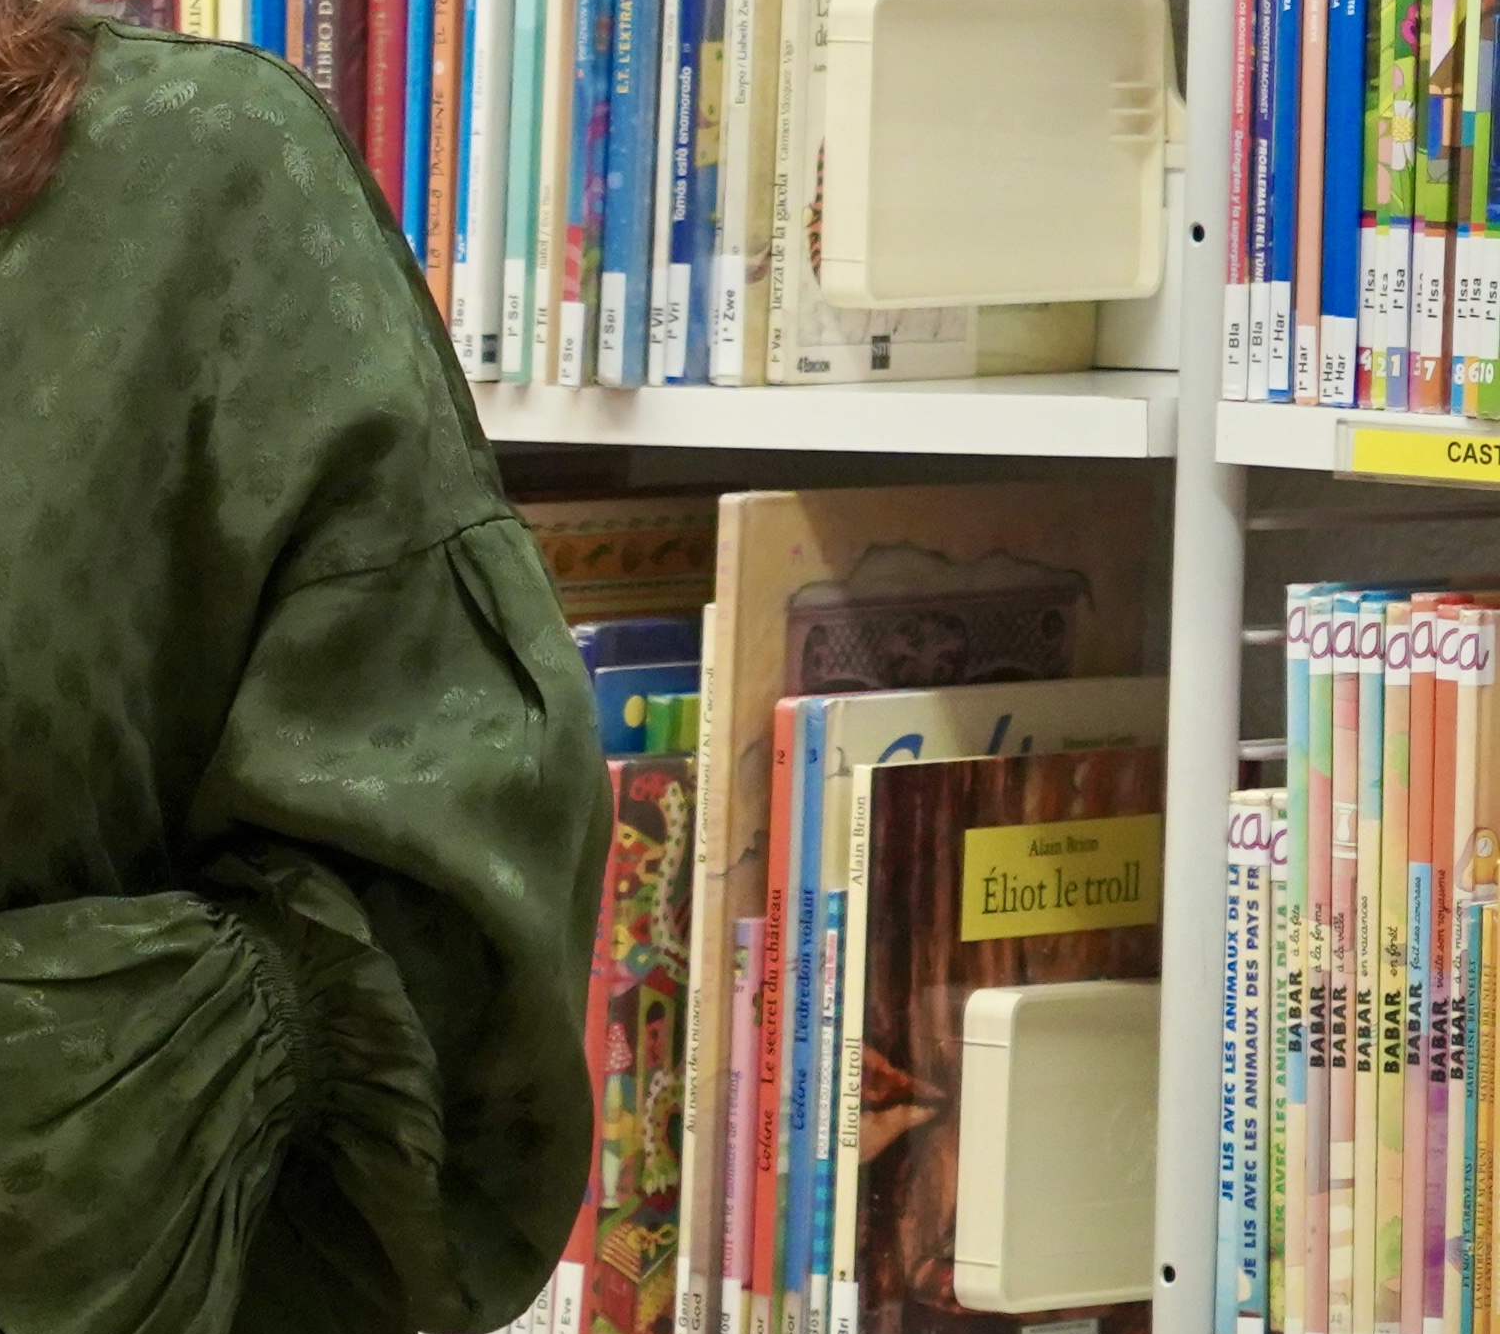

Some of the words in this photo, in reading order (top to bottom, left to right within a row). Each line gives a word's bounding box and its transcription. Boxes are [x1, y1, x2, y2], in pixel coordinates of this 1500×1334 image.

[1261, 15, 1271, 62] MONSTER
[677, 66, 693, 144] enamorado
[1257, 138, 1268, 215] PROBLEMAS
[673, 179, 688, 221] Tomás
[851, 796, 867, 838] Brion
[850, 843, 866, 886] Alain
[1028, 836, 1060, 858] Alain
[1063, 835, 1100, 857] Brion
[981, 870, 1036, 917] Éliot
[1053, 876, 1080, 910] le
[1085, 861, 1141, 906] troll
[764, 888, 782, 963] château
[1246, 900, 1260, 950] PAYS
[1224, 931, 1239, 1032] ANIMAUX
[1245, 959, 1259, 998] DES
[1288, 969, 1302, 1052] BABAR
[1309, 983, 1326, 1068] BABAR
[1331, 984, 1347, 1068] BABAR
[1356, 988, 1372, 1073] BABAR
[1383, 989, 1401, 1074] BABAR
[763, 1012, 778, 1056] secret
[761, 1060, 776, 1086] Le
[843, 1037, 861, 1078] troll
[1223, 1041, 1236, 1074] LES
[1245, 1006, 1259, 1108] ANIMAUX
[838, 1104, 859, 1148] Éliot
[1223, 1080, 1236, 1134] AVEC
[1222, 1140, 1235, 1170] LIS
[1244, 1117, 1258, 1151] LES
[1222, 1179, 1235, 1201] JE
[1244, 1157, 1258, 1208] AVEC
[1244, 1219, 1257, 1249] LIS
[1244, 1257, 1257, 1278] JE
